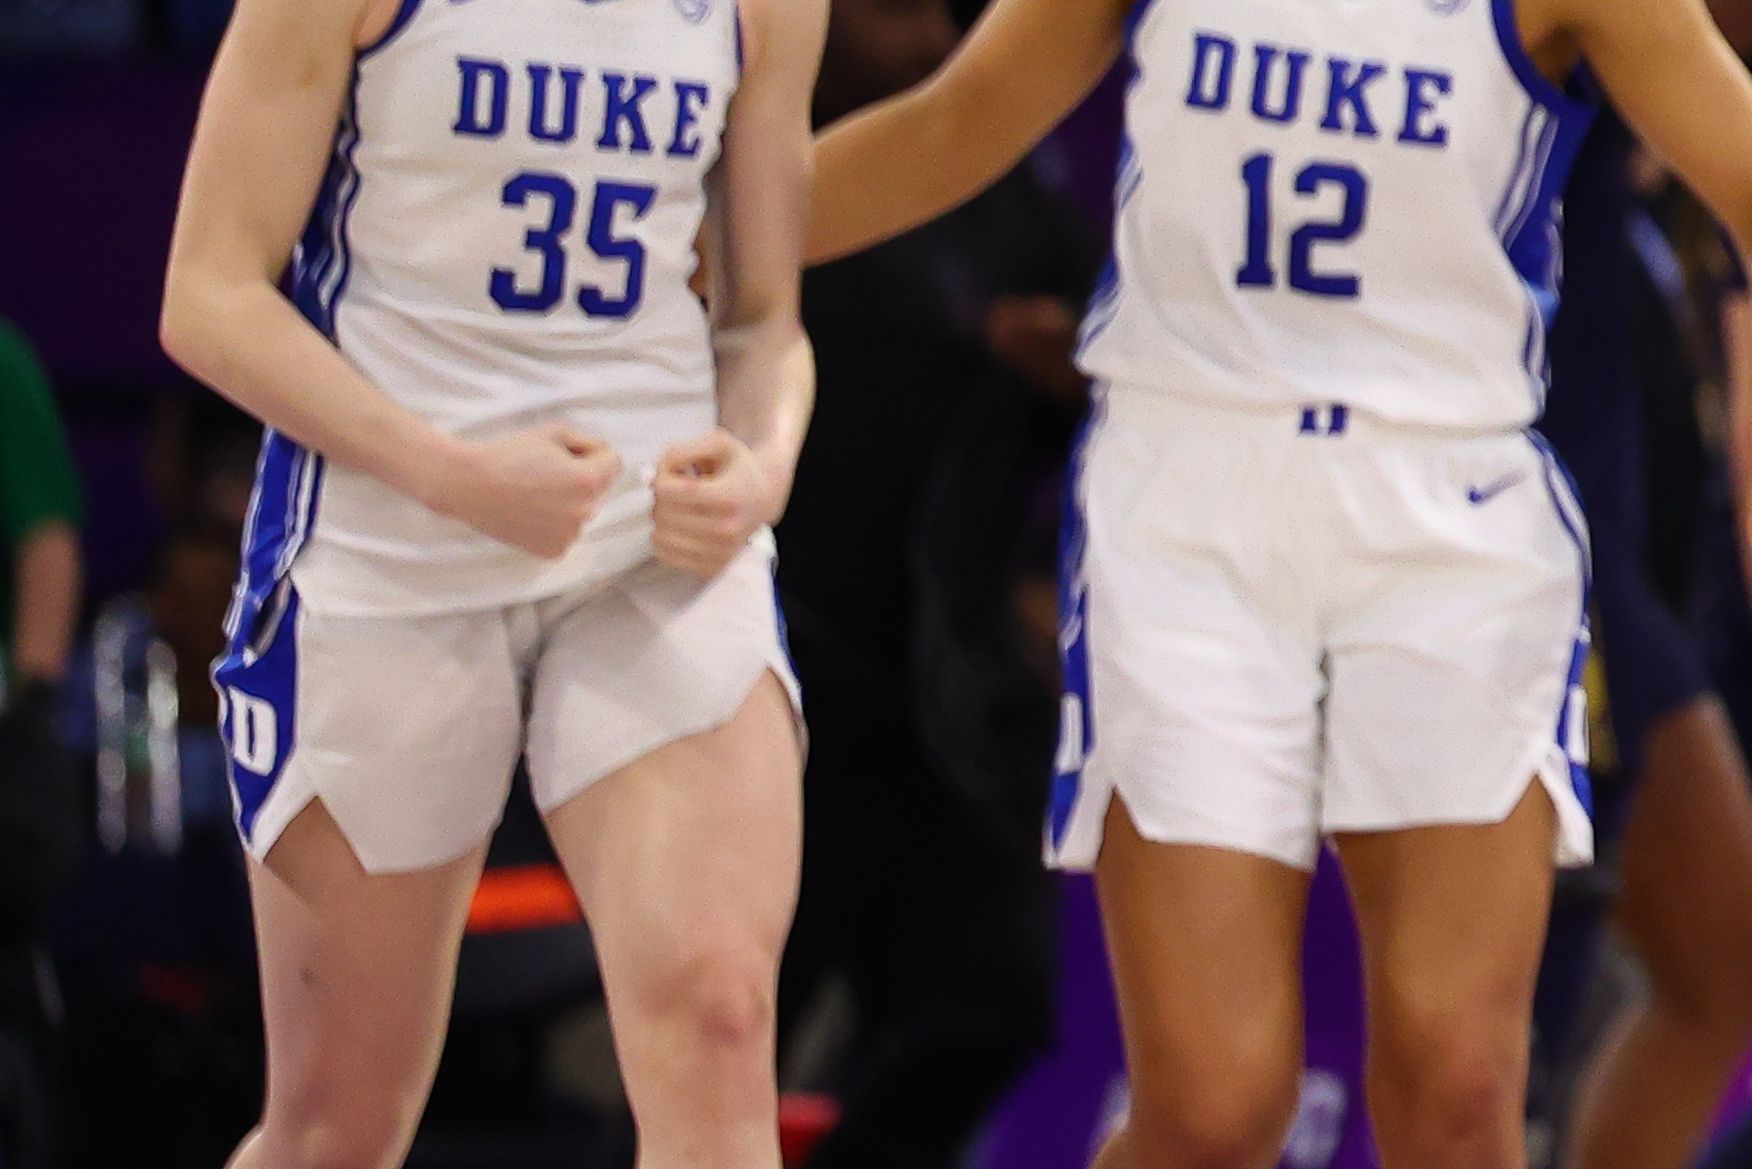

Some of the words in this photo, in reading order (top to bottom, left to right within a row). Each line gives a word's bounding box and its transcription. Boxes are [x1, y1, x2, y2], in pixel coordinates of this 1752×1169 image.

[453, 56, 709, 157] DUKE
[1185, 31, 1453, 151] DUKE
[489, 172, 656, 316] 35
[1236, 153, 1369, 298] 12
[229, 685, 278, 776] D
